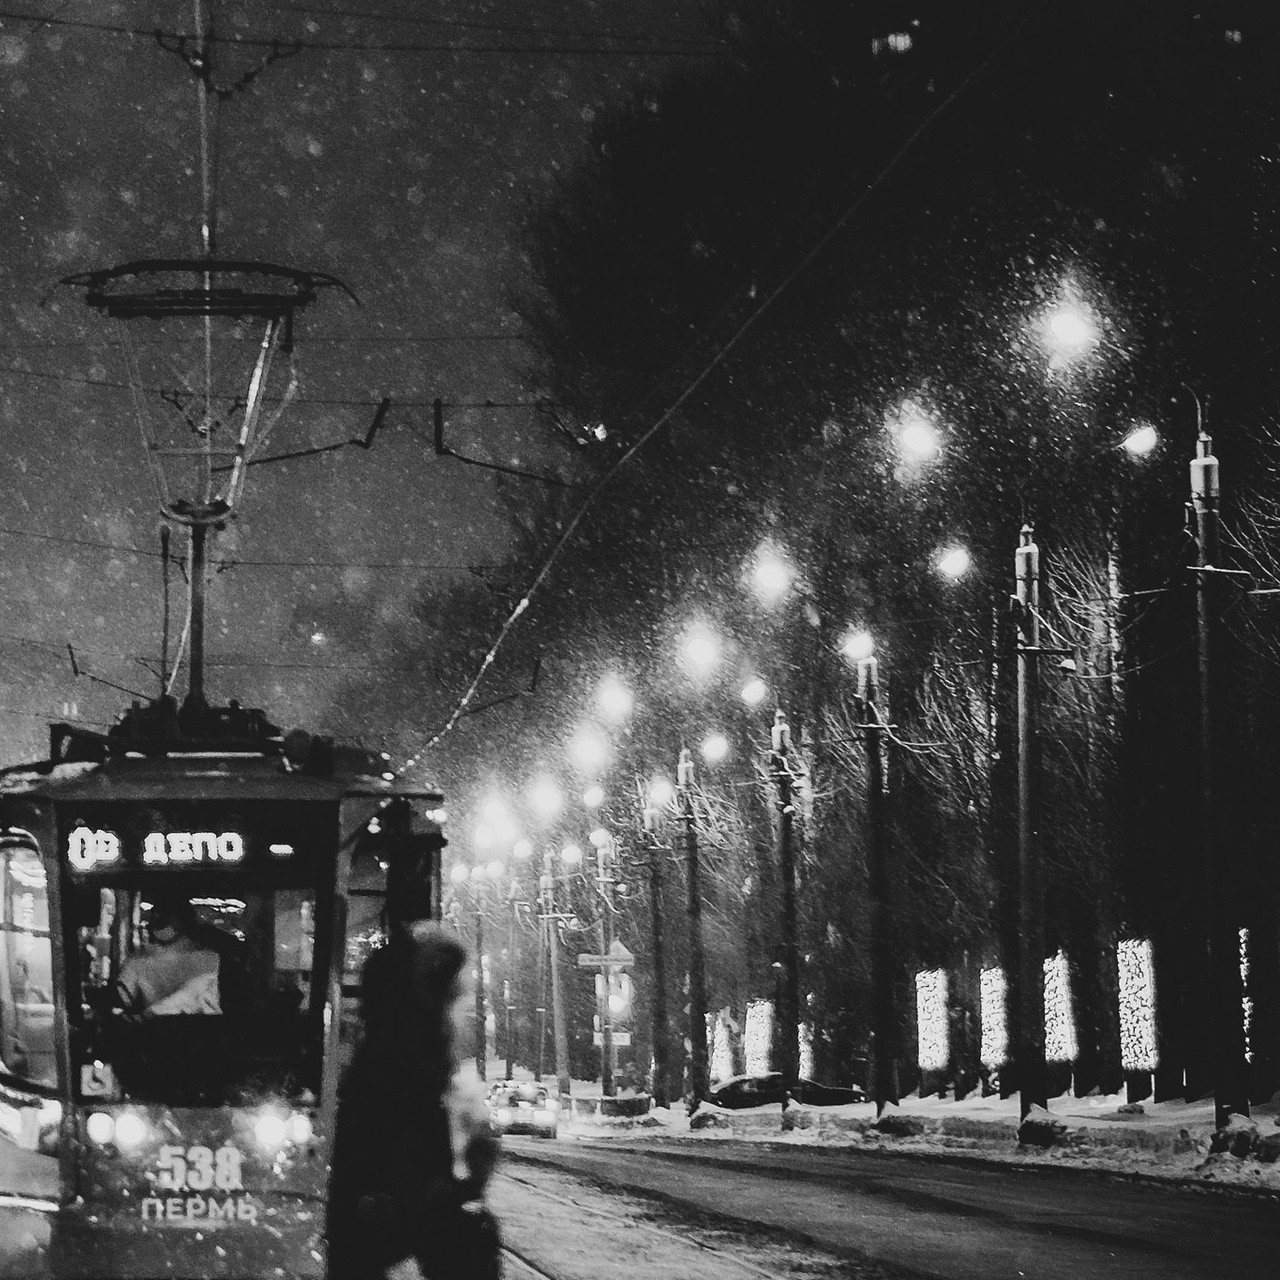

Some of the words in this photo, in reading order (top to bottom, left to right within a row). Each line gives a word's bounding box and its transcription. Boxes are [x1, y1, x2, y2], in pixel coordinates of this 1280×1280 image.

[143, 831, 244, 864] ДЕПО
[158, 1145, 243, 1190] 538
[141, 1196, 258, 1220] ПЕРМЬ
